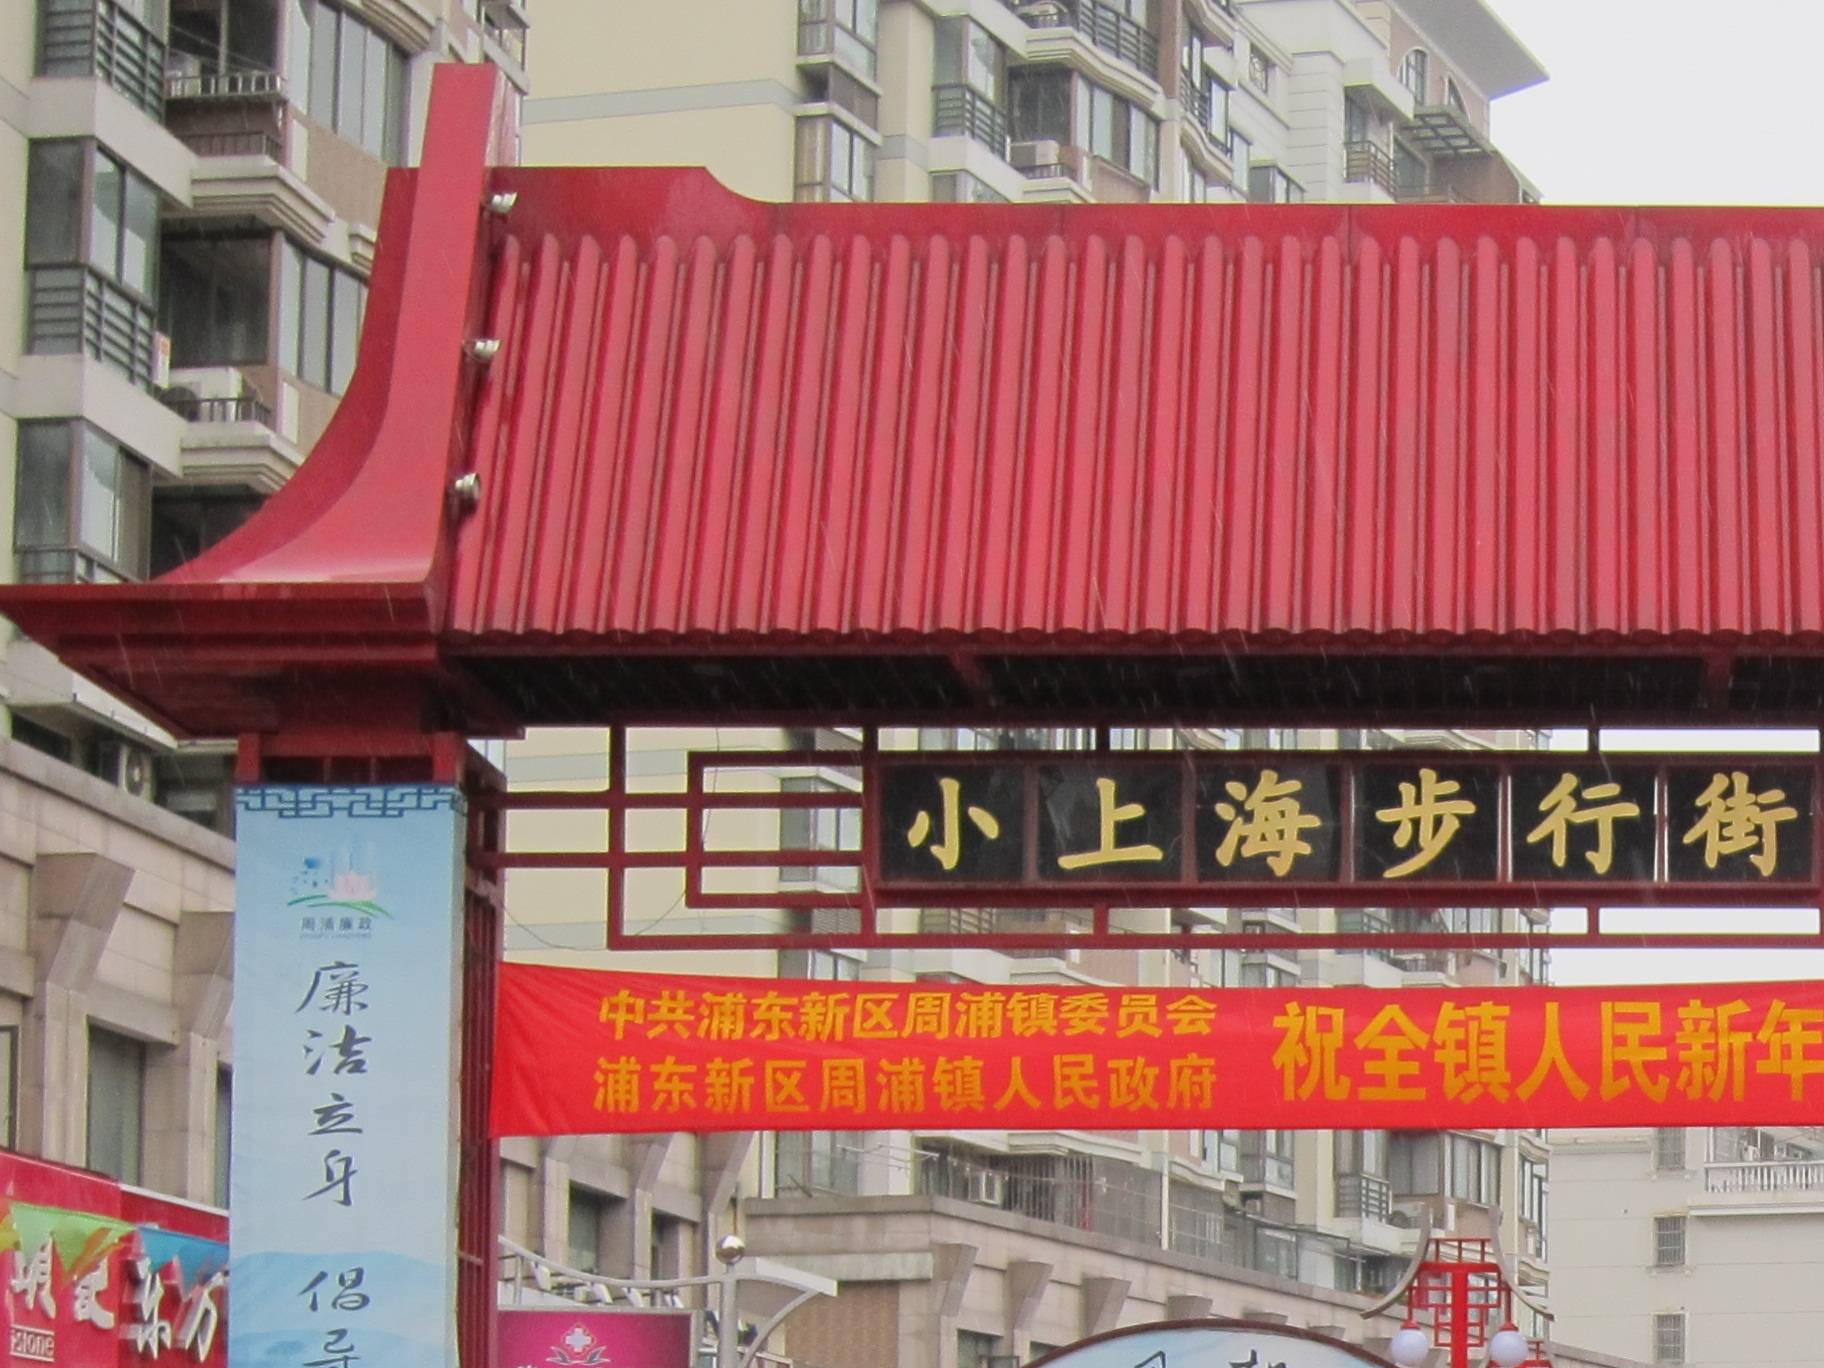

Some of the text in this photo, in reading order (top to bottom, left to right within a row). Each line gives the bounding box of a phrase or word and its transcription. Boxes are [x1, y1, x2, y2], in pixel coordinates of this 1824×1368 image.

[906, 767, 1799, 878] 小上海步行街
[599, 990, 1217, 1042] 中共浦东新区周浦镇委员会
[296, 961, 373, 1208] 廉洁立身
[593, 1053, 1218, 1115] 浦东新区周浦镇人民政府
